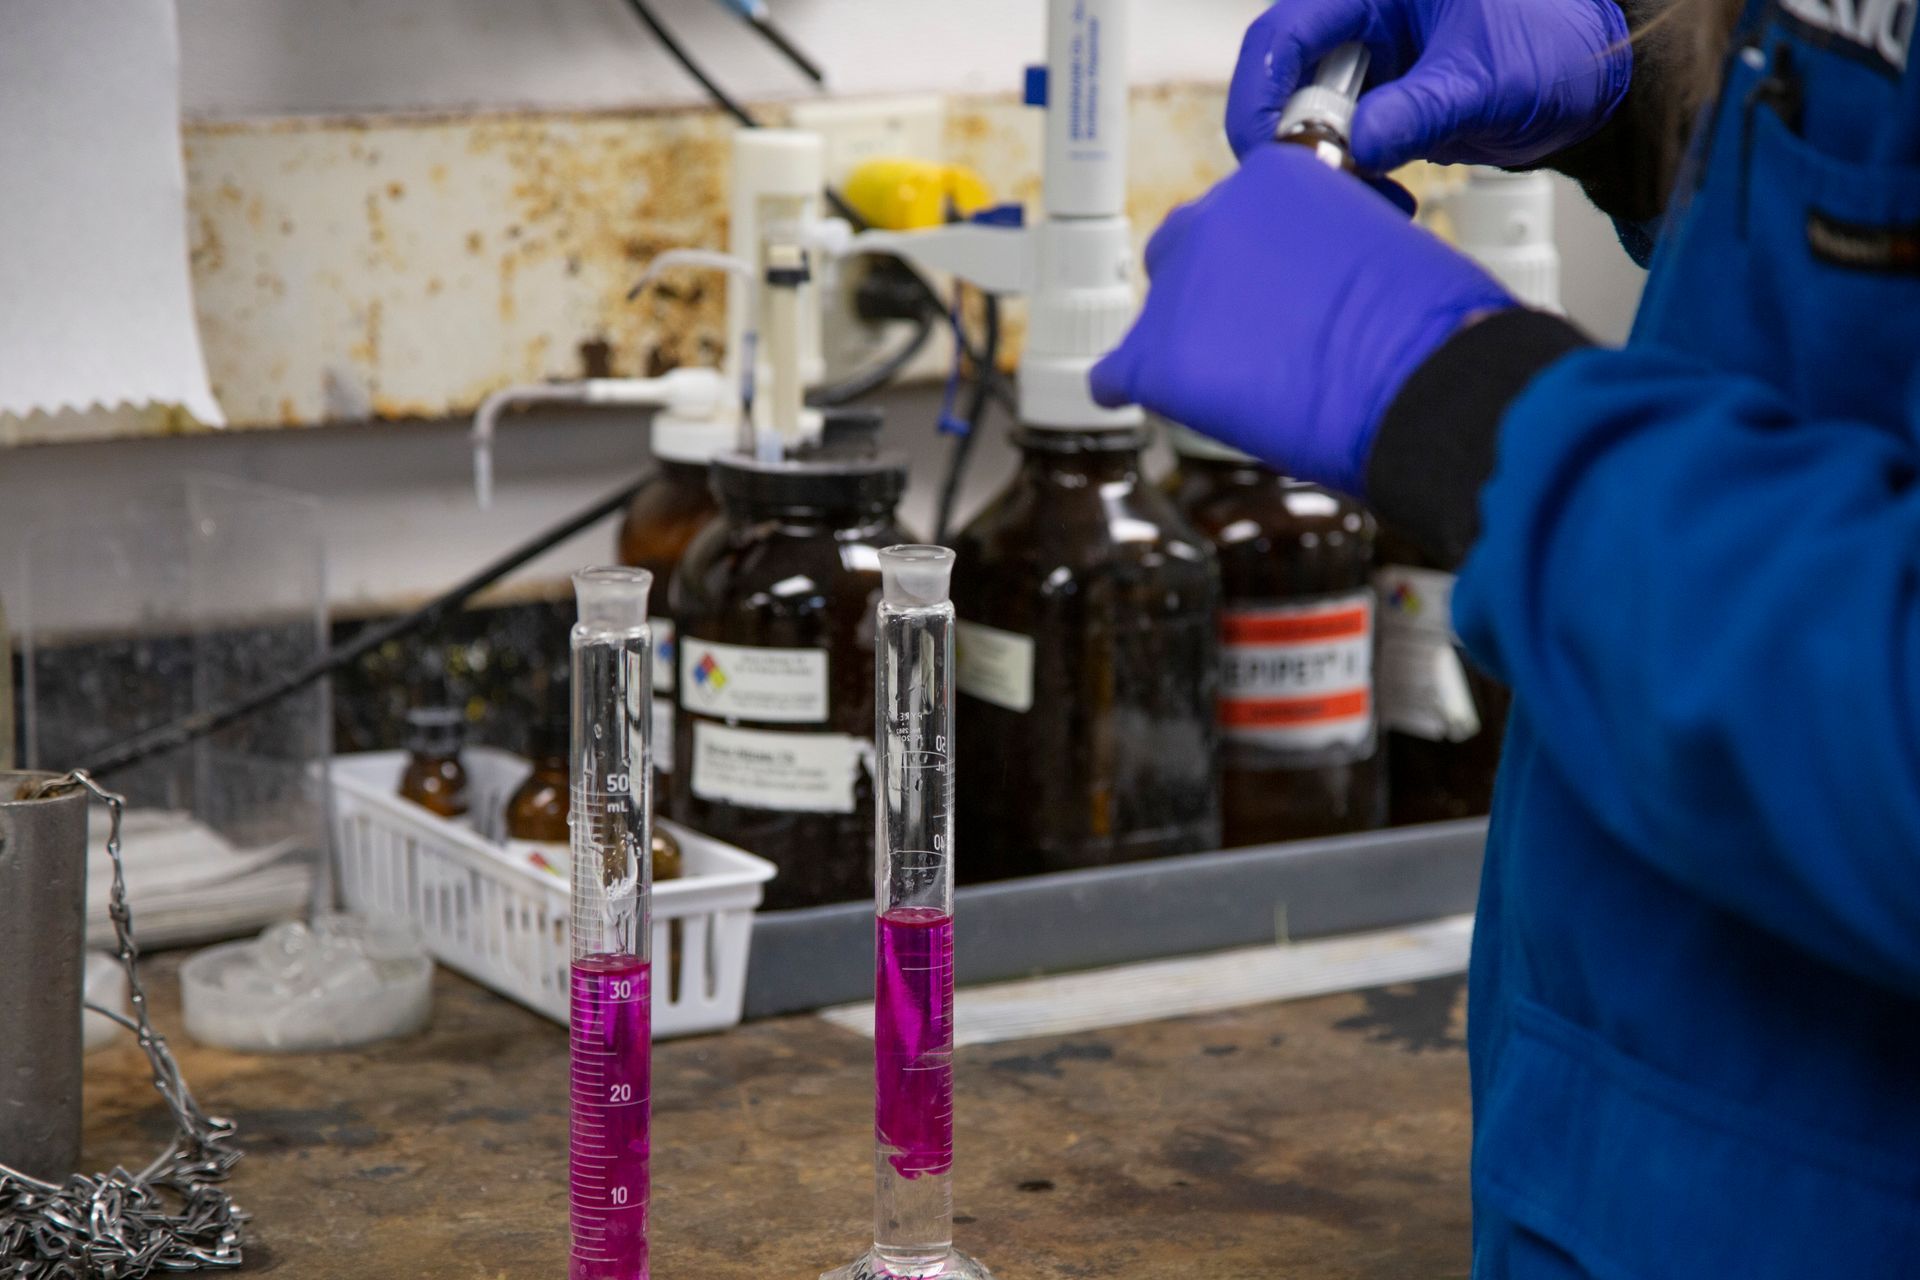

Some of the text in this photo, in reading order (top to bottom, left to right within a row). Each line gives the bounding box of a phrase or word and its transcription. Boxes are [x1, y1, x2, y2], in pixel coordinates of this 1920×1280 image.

[607, 774, 629, 792] 50
[607, 801, 628, 812] mL
[610, 981, 631, 999] 30
[610, 1084, 631, 1102] 20
[611, 1186, 628, 1204] 10
